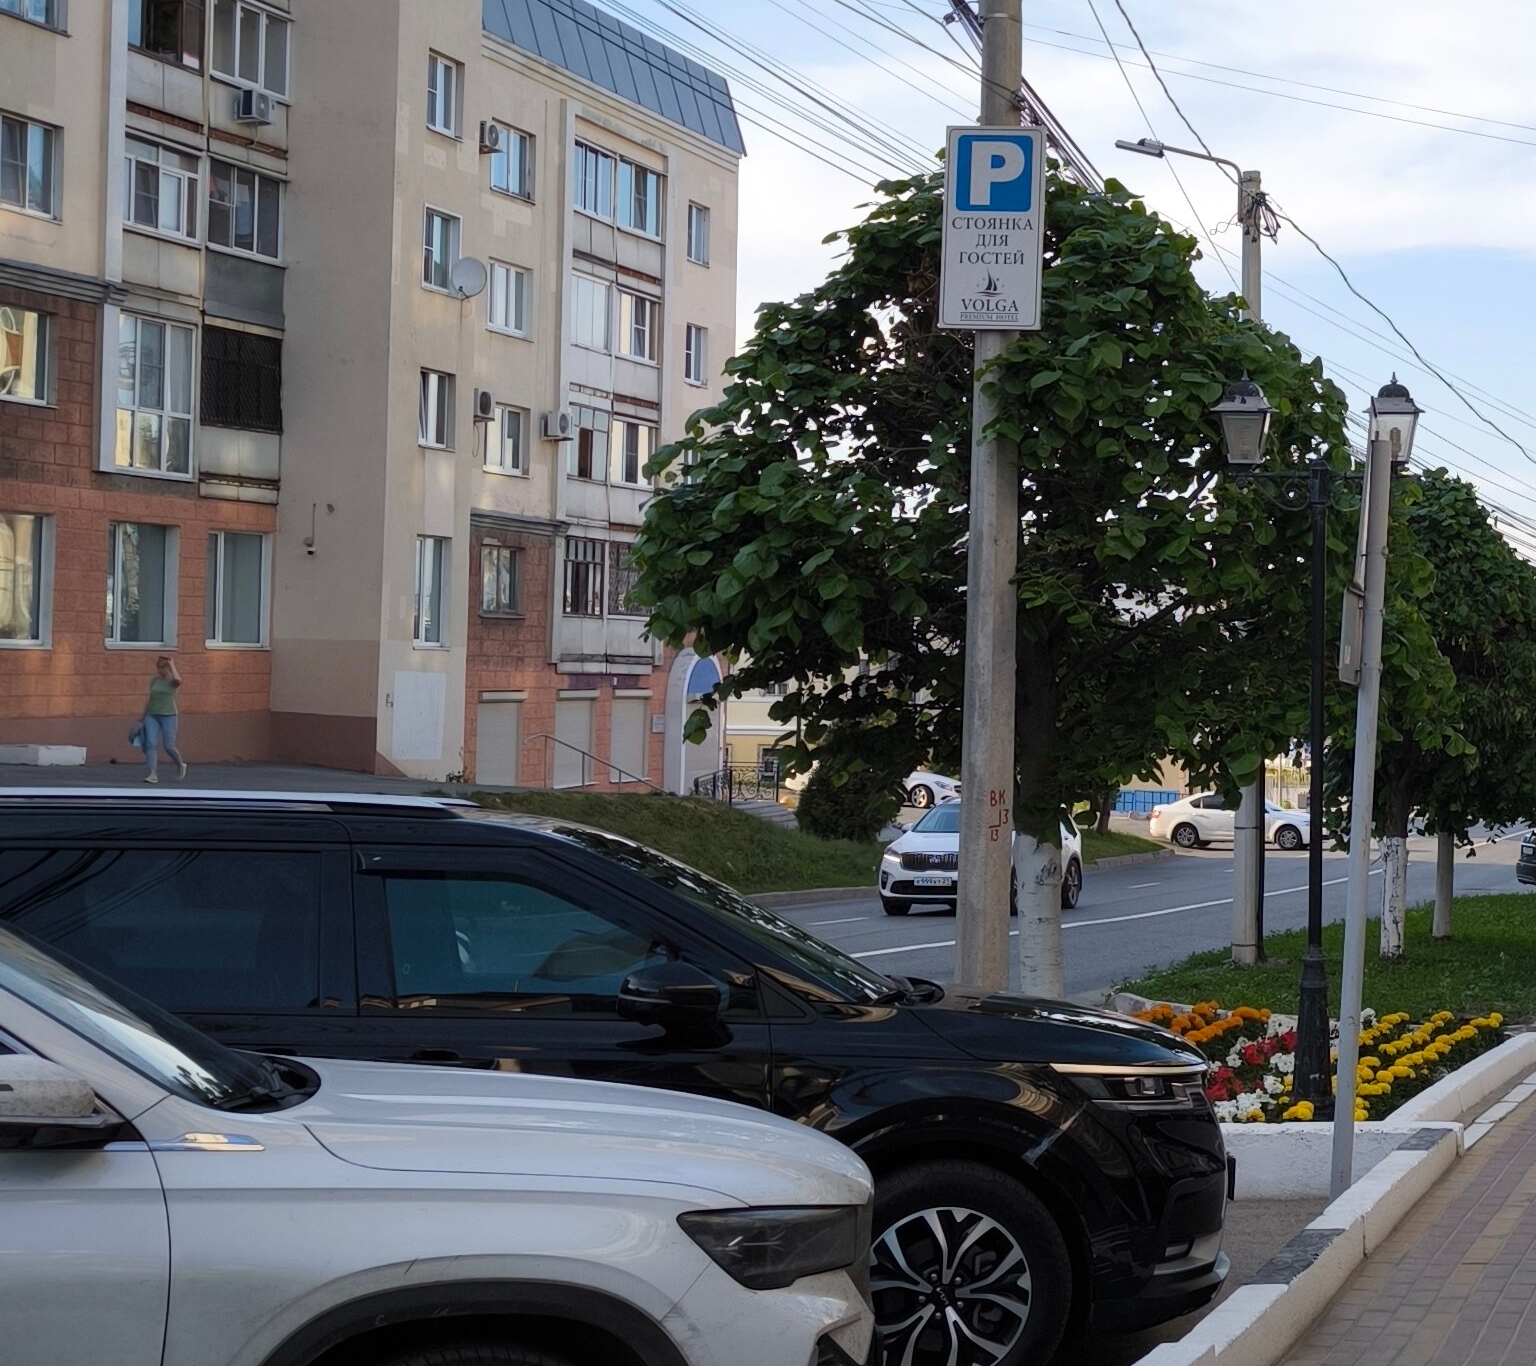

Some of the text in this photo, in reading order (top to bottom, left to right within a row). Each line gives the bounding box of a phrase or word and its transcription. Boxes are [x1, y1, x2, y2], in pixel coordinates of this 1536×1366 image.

[969, 141, 1026, 206] P
[951, 217, 1034, 231] СТОЯНКА
[975, 234, 1009, 248] ДЛЯ
[959, 250, 1025, 265] ГОСТЕЙ
[961, 298, 1019, 312] VOLGA
[1002, 808, 1009, 825] 3
[990, 829, 999, 842] 13
